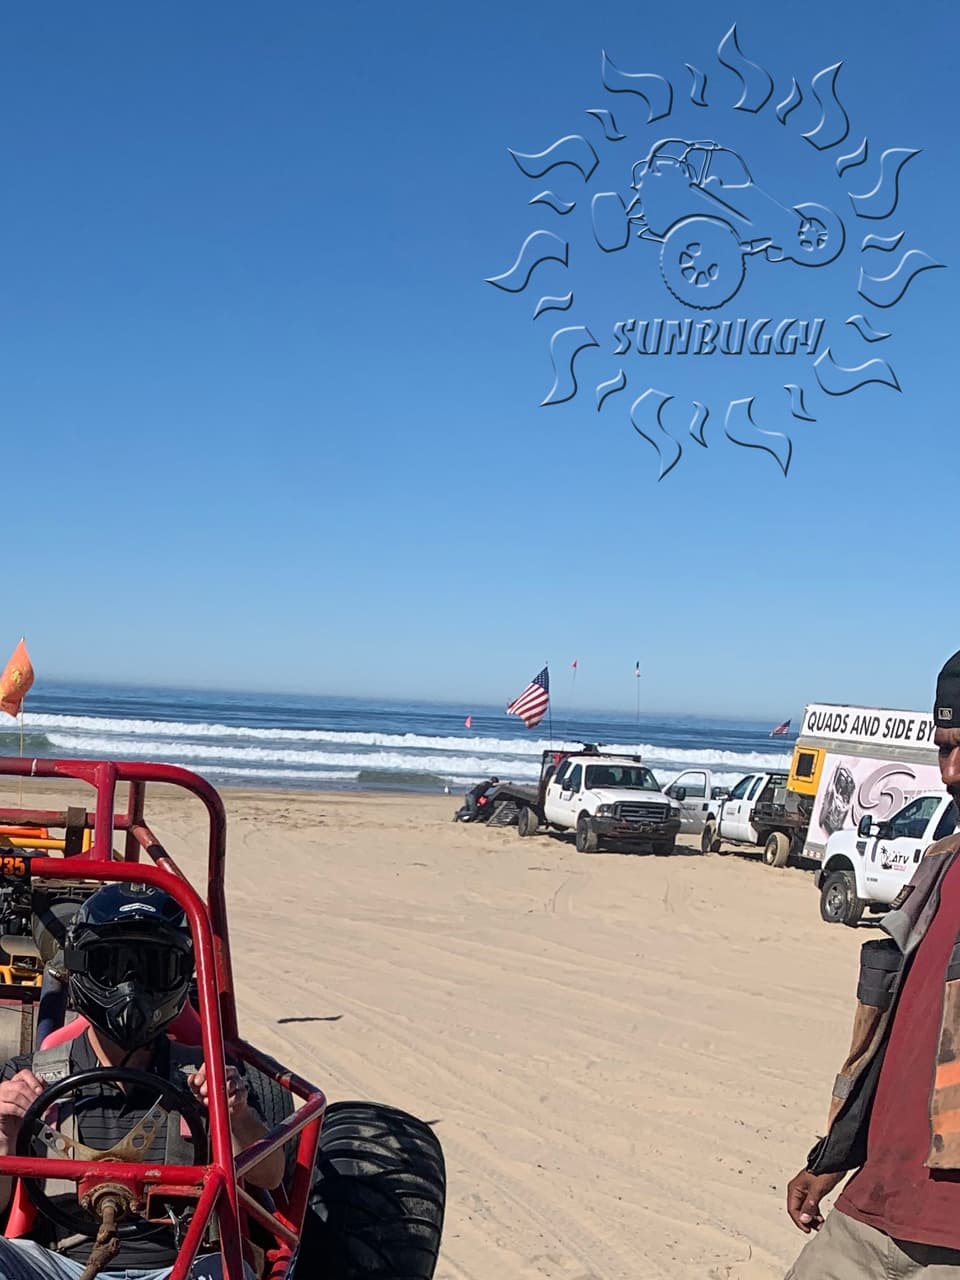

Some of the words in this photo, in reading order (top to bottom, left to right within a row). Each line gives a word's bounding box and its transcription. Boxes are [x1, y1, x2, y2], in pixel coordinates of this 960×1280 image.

[807, 711, 850, 735] QUADS
[850, 714, 881, 738] AND
[882, 717, 915, 740] SIDE
[916, 720, 936, 742] BY
[892, 854, 910, 864] ATV
